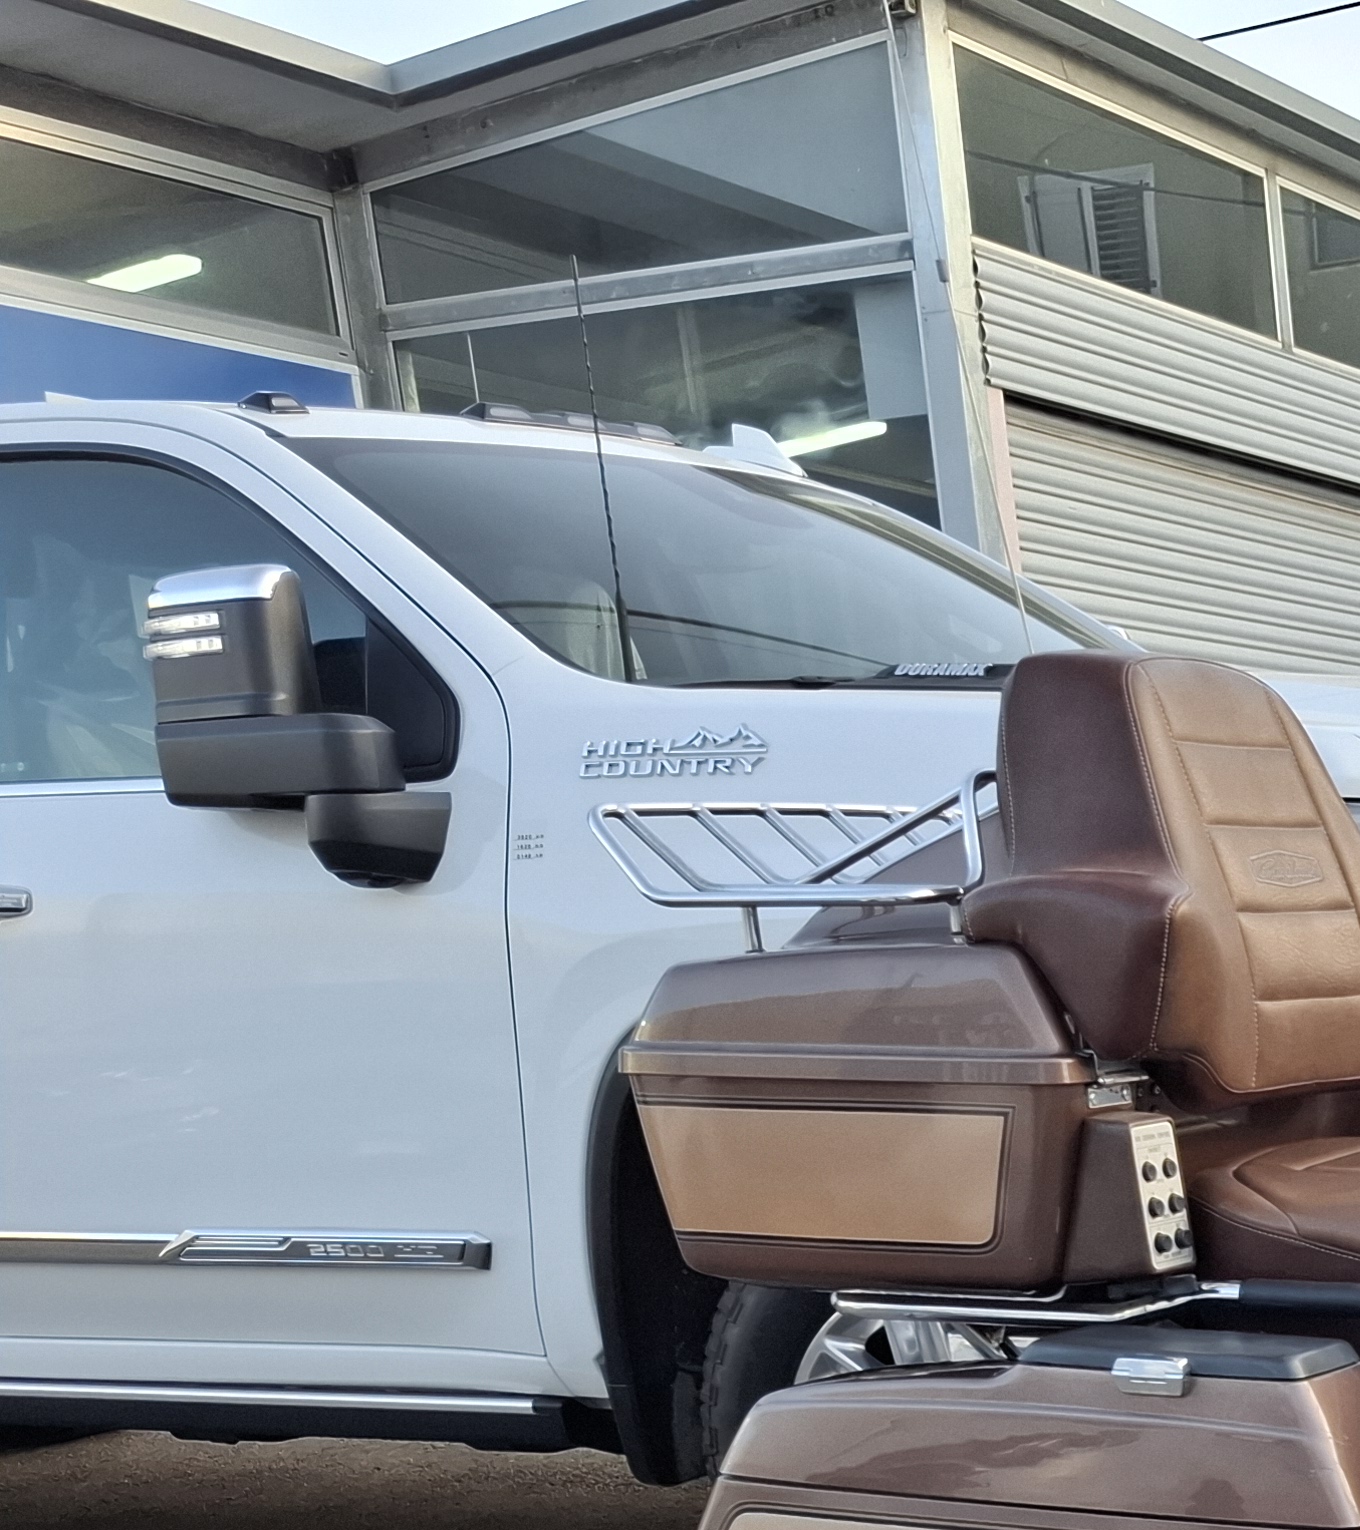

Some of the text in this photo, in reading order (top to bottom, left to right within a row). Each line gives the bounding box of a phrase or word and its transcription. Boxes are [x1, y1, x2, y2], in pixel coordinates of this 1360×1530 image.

[581, 739, 671, 758] HIGH
[579, 756, 767, 778] COUNTRY
[306, 1244, 385, 1257] 2500
